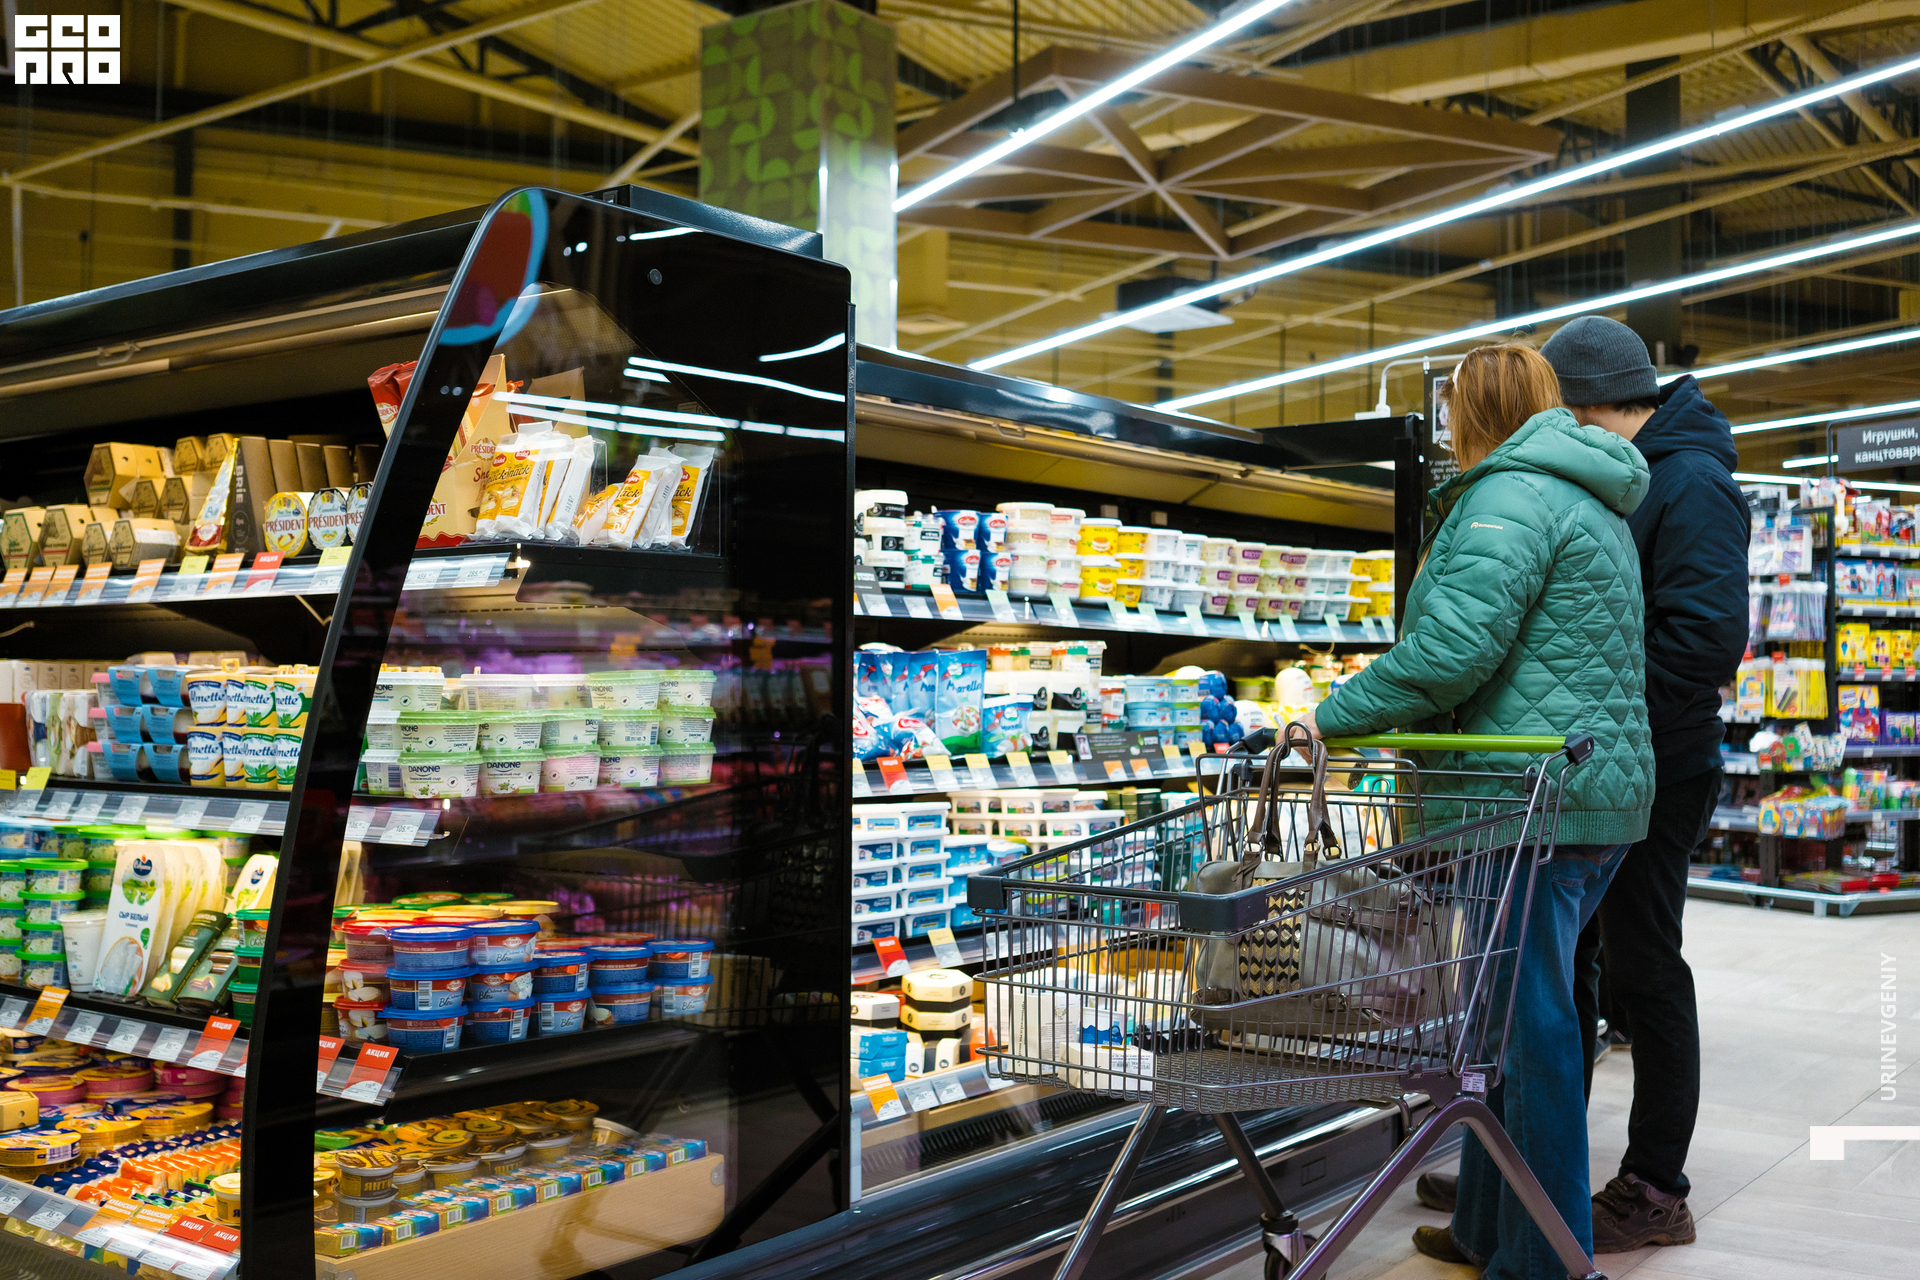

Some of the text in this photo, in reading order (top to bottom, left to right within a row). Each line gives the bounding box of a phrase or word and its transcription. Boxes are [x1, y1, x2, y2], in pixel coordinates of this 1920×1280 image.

[1862, 427, 1919, 446] Игрушки,
[266, 518, 305, 534] PRÉSIDENT
[408, 765, 440, 773] DANONE
[487, 761, 521, 769] DANONE
[211, 1020, 233, 1031] АКЦИЯ
[366, 1048, 390, 1058] АКЦИЯ
[108, 1199, 139, 1212] КУБАНСКИЙ
[140, 1208, 173, 1220] КУБАНСКИЙ
[180, 1220, 204, 1231] АКЦИЯ
[214, 1230, 239, 1242] АКЦИЯ
